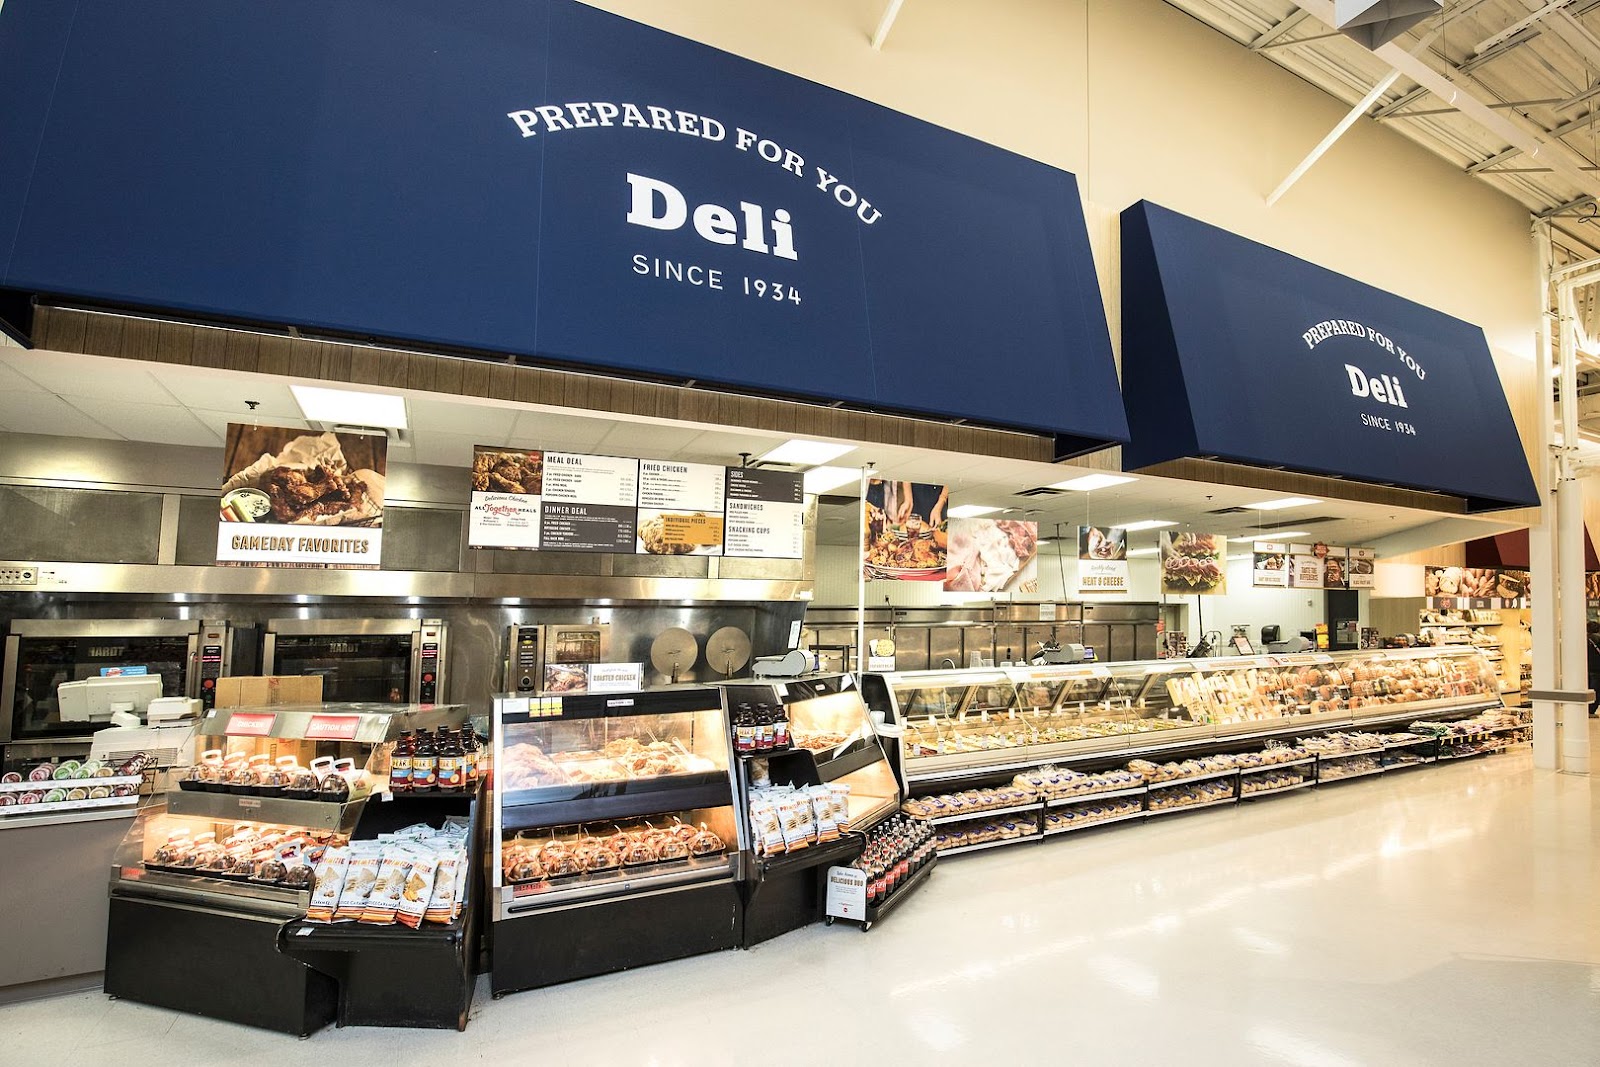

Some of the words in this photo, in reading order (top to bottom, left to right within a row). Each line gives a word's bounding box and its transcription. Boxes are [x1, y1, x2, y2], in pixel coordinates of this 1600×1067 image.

[507, 102, 727, 142] PREPARED
[736, 127, 806, 178] FOR
[815, 166, 883, 226] YOU
[626, 172, 799, 262] Deli
[632, 254, 724, 290] SINCE
[743, 276, 802, 305] 1934
[1302, 319, 1366, 350] PREPARED
[1366, 326, 1396, 355] FOR
[1396, 346, 1426, 381] YOU
[1344, 363, 1409, 409] Deli
[1361, 413, 1392, 431] SINCE
[1395, 421, 1416, 436] 1934
[547, 456, 564, 464] MEAL
[566, 457, 583, 466] DEAL
[643, 463, 661, 472] FRIED
[662, 465, 688, 474] CHICKEN
[730, 470, 744, 478] SIDES
[484, 503, 521, 517] Together
[544, 505, 570, 515] DINNER
[571, 507, 588, 516] DEAL
[729, 502, 764, 511] SANDWICHES
[728, 526, 755, 534] SNACKING
[756, 527, 770, 535] CUPS
[231, 535, 296, 552] GAMEDAY
[298, 537, 370, 554] FAVORITES
[1082, 576, 1098, 586] MEAT
[1103, 576, 1124, 586] CHEESE
[830, 876, 853, 886] DELICIOUS
